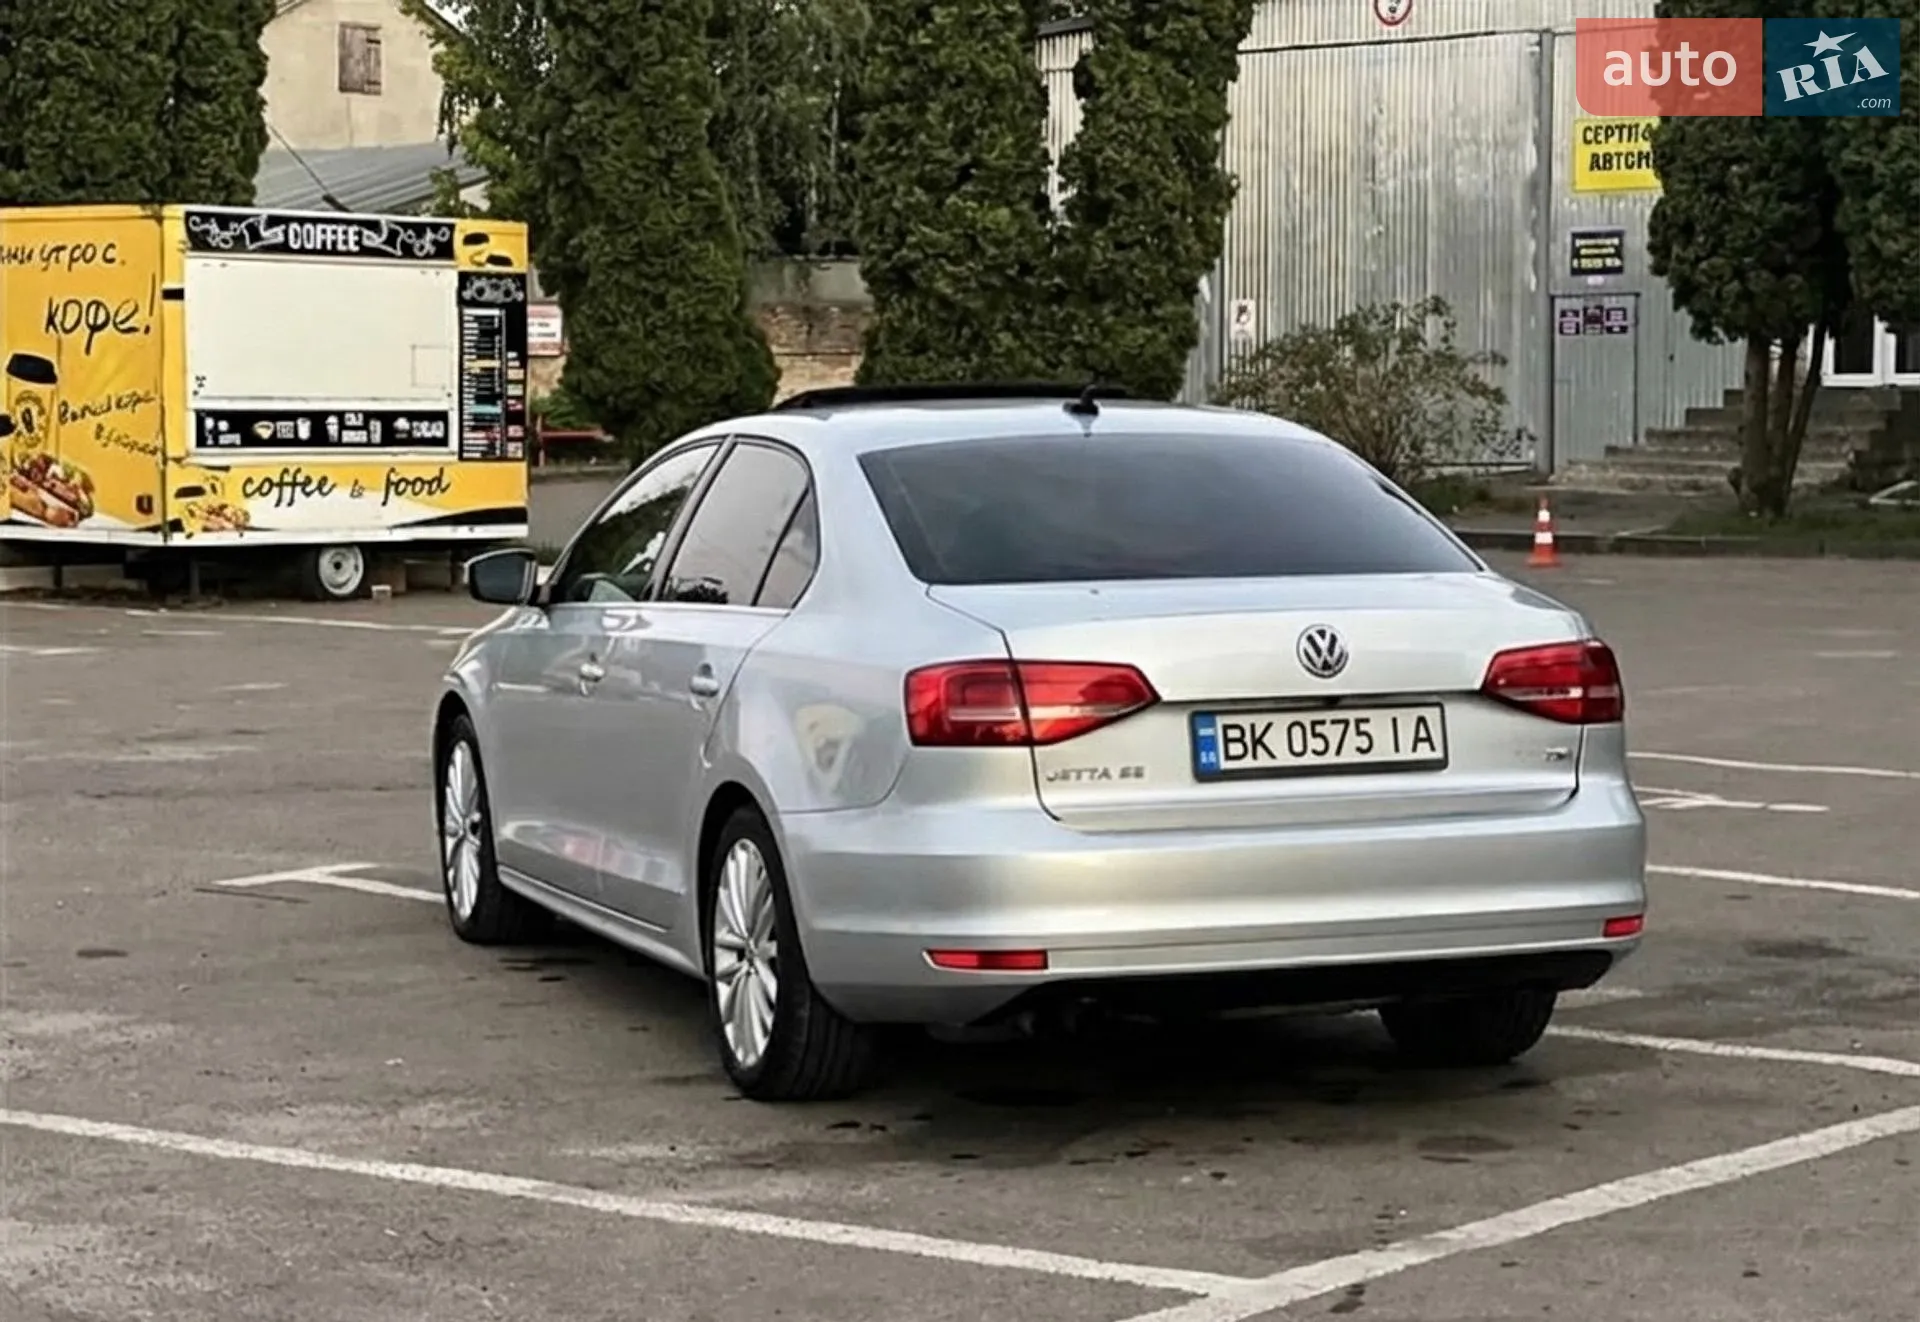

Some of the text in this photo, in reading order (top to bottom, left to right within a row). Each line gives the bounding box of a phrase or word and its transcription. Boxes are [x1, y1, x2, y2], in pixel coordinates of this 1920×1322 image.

[288, 222, 360, 252] COFFEE
[242, 467, 338, 508] coffee
[381, 466, 451, 507] food
[1222, 721, 1277, 761] BK
[1287, 717, 1374, 757] 0575
[1045, 766, 1113, 782] JETTA
